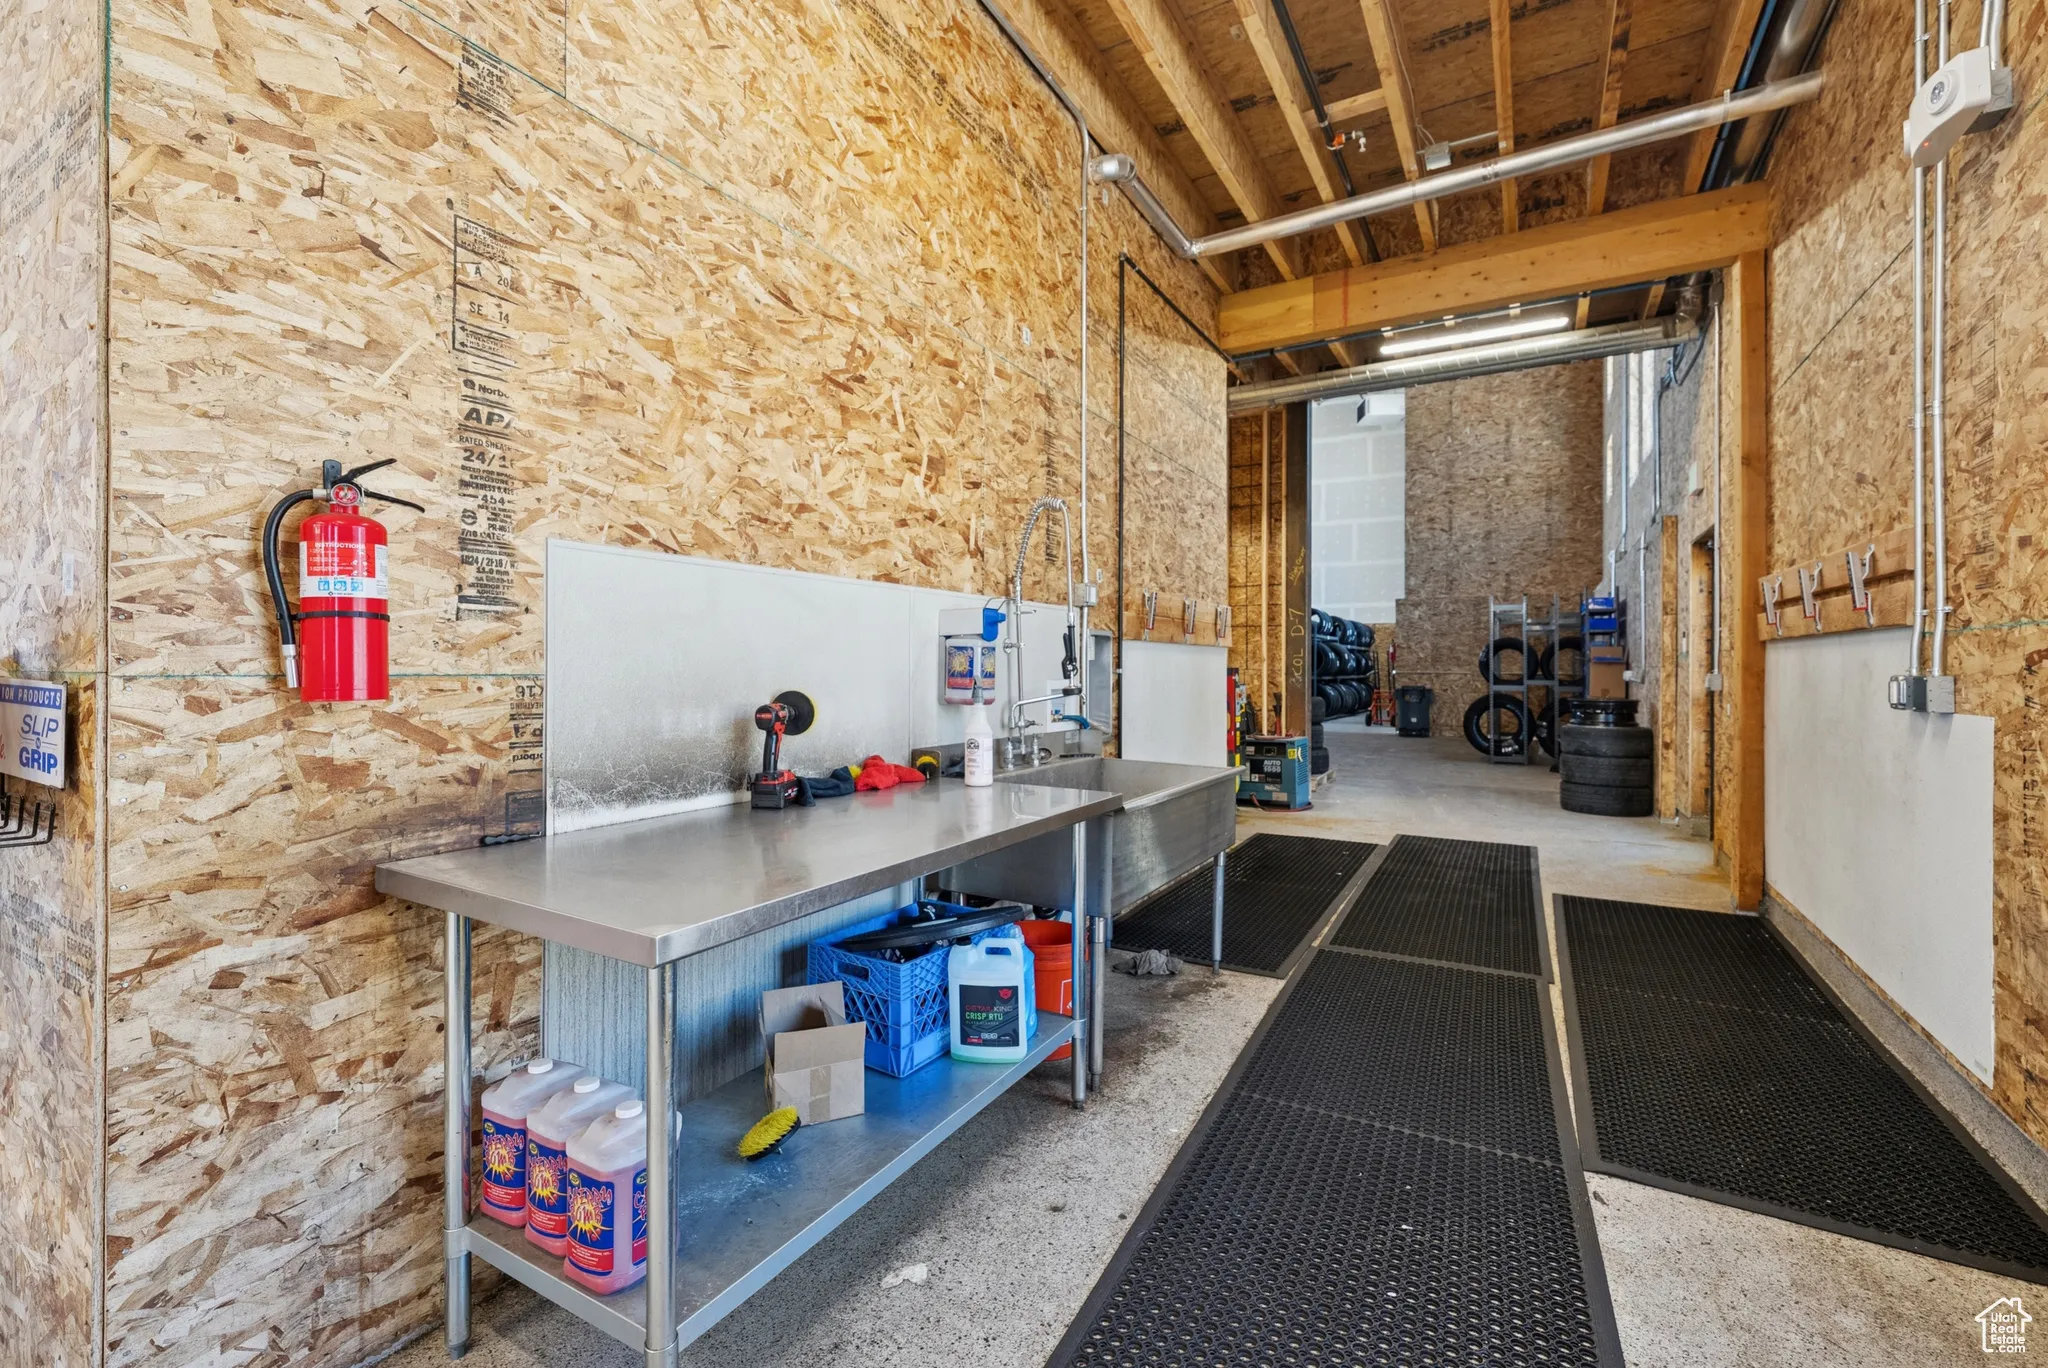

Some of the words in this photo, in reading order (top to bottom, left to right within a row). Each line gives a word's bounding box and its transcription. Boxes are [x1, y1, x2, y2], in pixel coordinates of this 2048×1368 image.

[474, 265, 482, 277] A
[469, 301, 484, 316] SE
[459, 435, 484, 446] RATED
[481, 494, 506, 507] 454
[1289, 608, 1304, 637] D-7
[18, 687, 61, 706] PRODUCTS
[21, 714, 59, 738] SLIP
[19, 746, 58, 774] GRIP
[966, 1012, 986, 1020] CRISP
